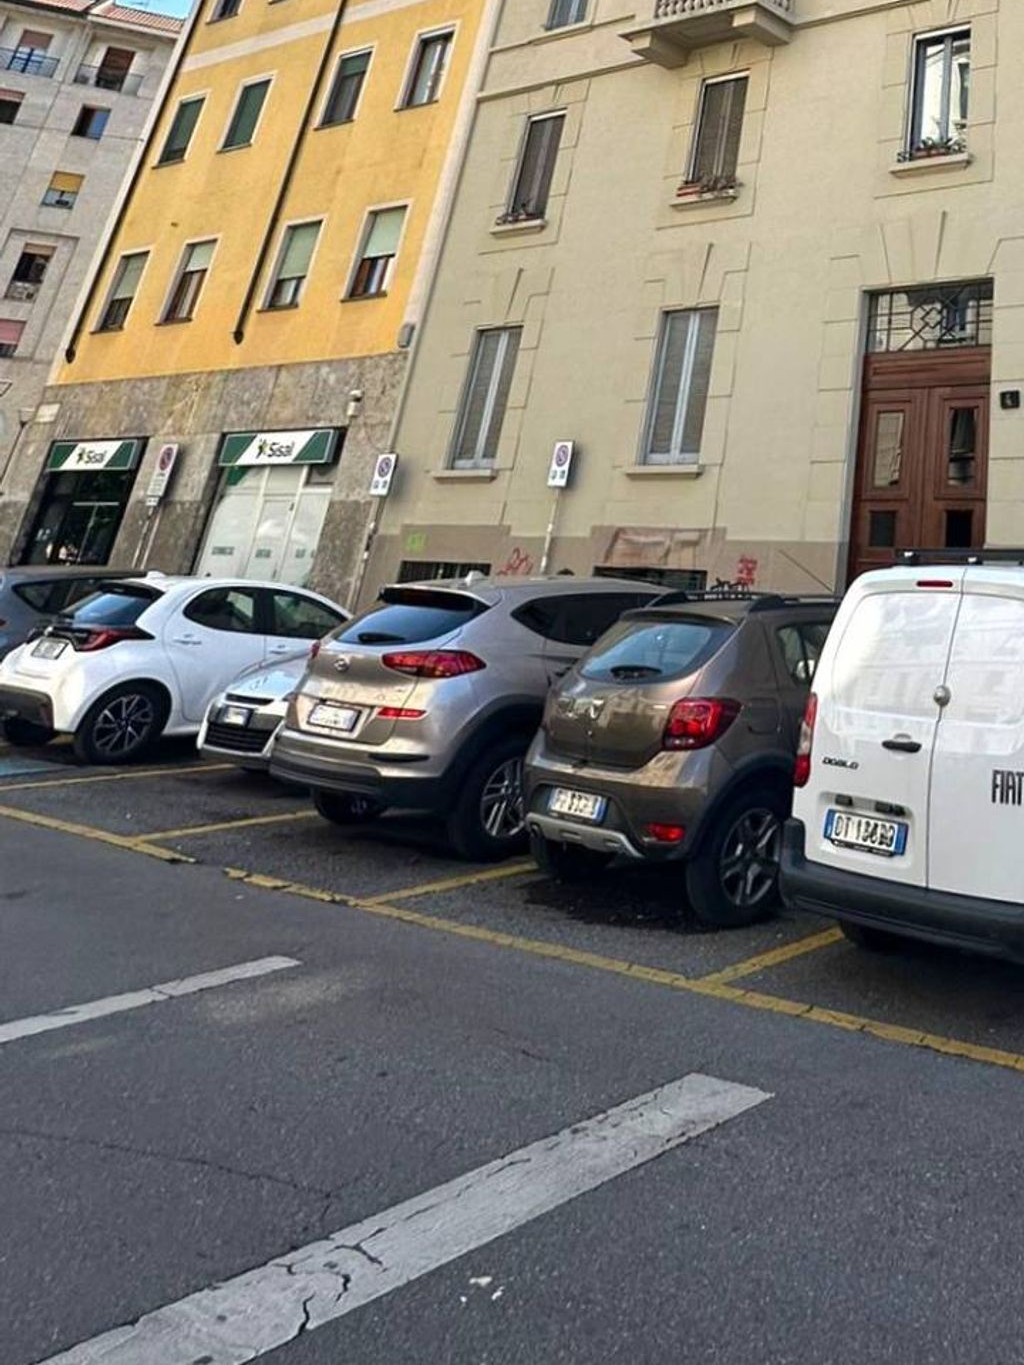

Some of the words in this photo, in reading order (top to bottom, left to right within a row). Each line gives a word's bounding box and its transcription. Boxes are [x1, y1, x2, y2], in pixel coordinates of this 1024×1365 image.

[85, 449, 108, 465] Sisal
[267, 440, 295, 458] Sisal
[991, 769, 1024, 806] FIAT
